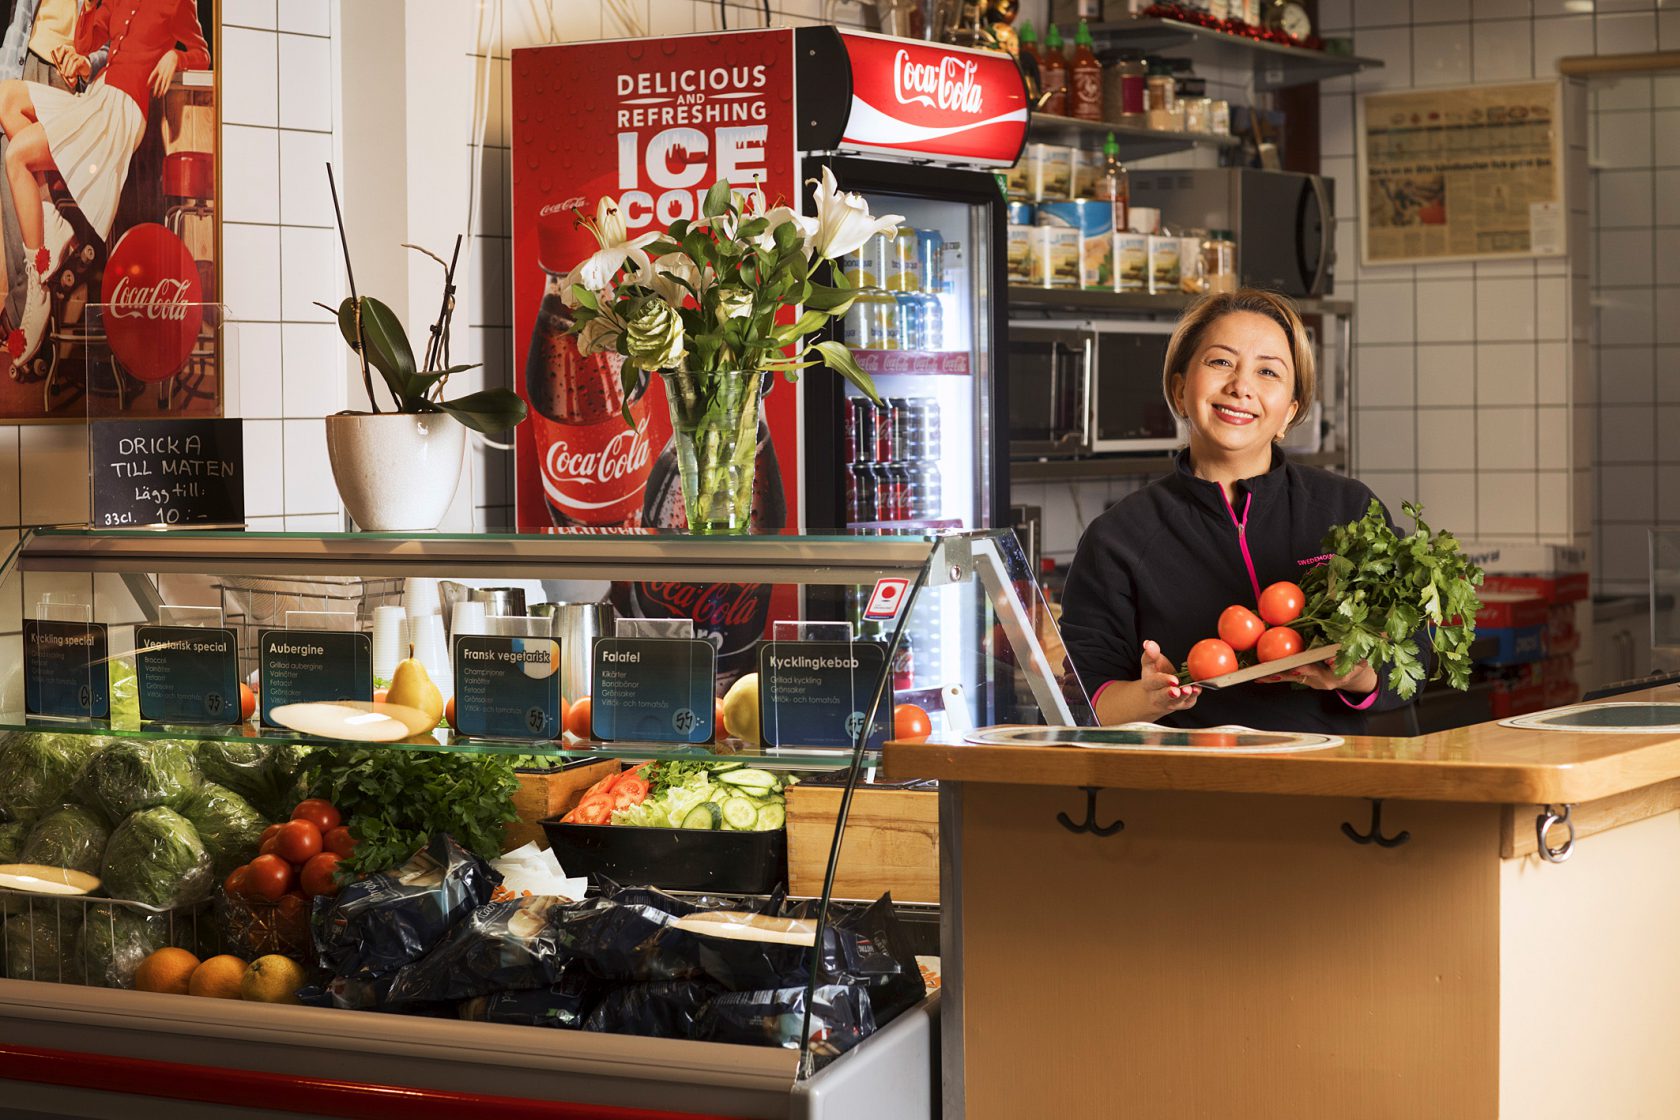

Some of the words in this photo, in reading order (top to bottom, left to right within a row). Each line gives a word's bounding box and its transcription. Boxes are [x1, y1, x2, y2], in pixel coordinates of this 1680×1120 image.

[617, 65, 767, 96] DELICIOUS
[894, 49, 983, 113] Coca-Cola
[676, 93, 705, 105] AND
[617, 101, 767, 128] REFRESHING
[617, 125, 768, 190] ICE
[540, 196, 586, 216] Coca-Cola
[618, 187, 767, 229] COD
[110, 276, 192, 321] Coca-Cola
[119, 435, 201, 455] DRICKA
[546, 410, 651, 485] Coca-Cola
[110, 460, 152, 478] TILL
[161, 459, 234, 478] MATEN
[135, 485, 170, 504] Lägg
[172, 482, 205, 498] till:
[31, 632, 63, 647] Kyckling
[65, 634, 95, 647] special
[193, 642, 227, 653] special
[269, 643, 324, 656] Aubergine
[464, 649, 495, 660] Fransk
[497, 650, 551, 664] vegetarisk
[602, 651, 640, 663] Falafel
[769, 656, 859, 670] Kycklingkebab
[794, 676, 822, 686] kyckling
